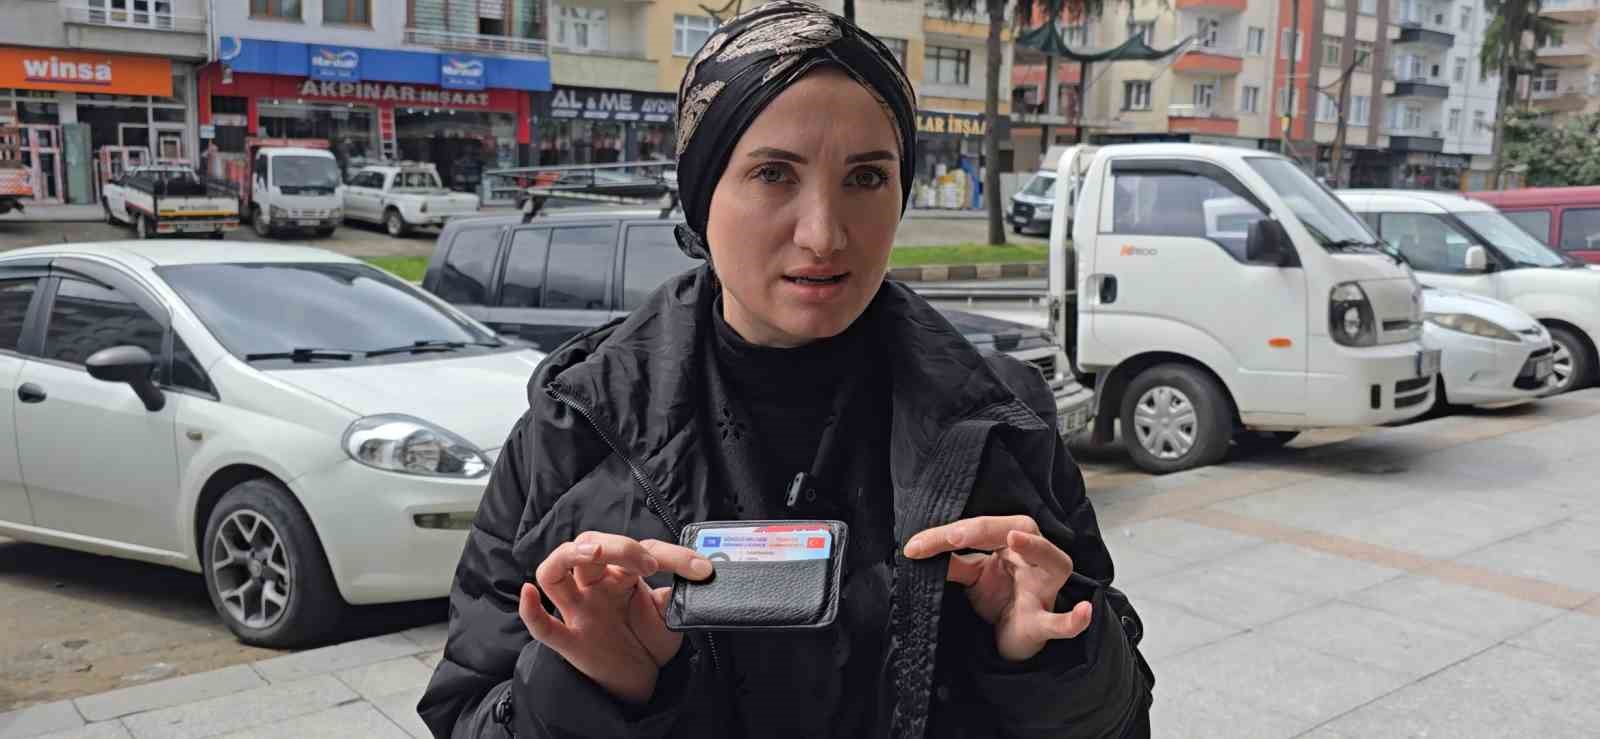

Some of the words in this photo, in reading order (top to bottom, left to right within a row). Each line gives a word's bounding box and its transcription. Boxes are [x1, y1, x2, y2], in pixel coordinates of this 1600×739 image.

[24, 56, 112, 80] winsa
[301, 80, 415, 101] AKPINAR
[552, 90, 583, 109] AL
[600, 93, 633, 112] ME
